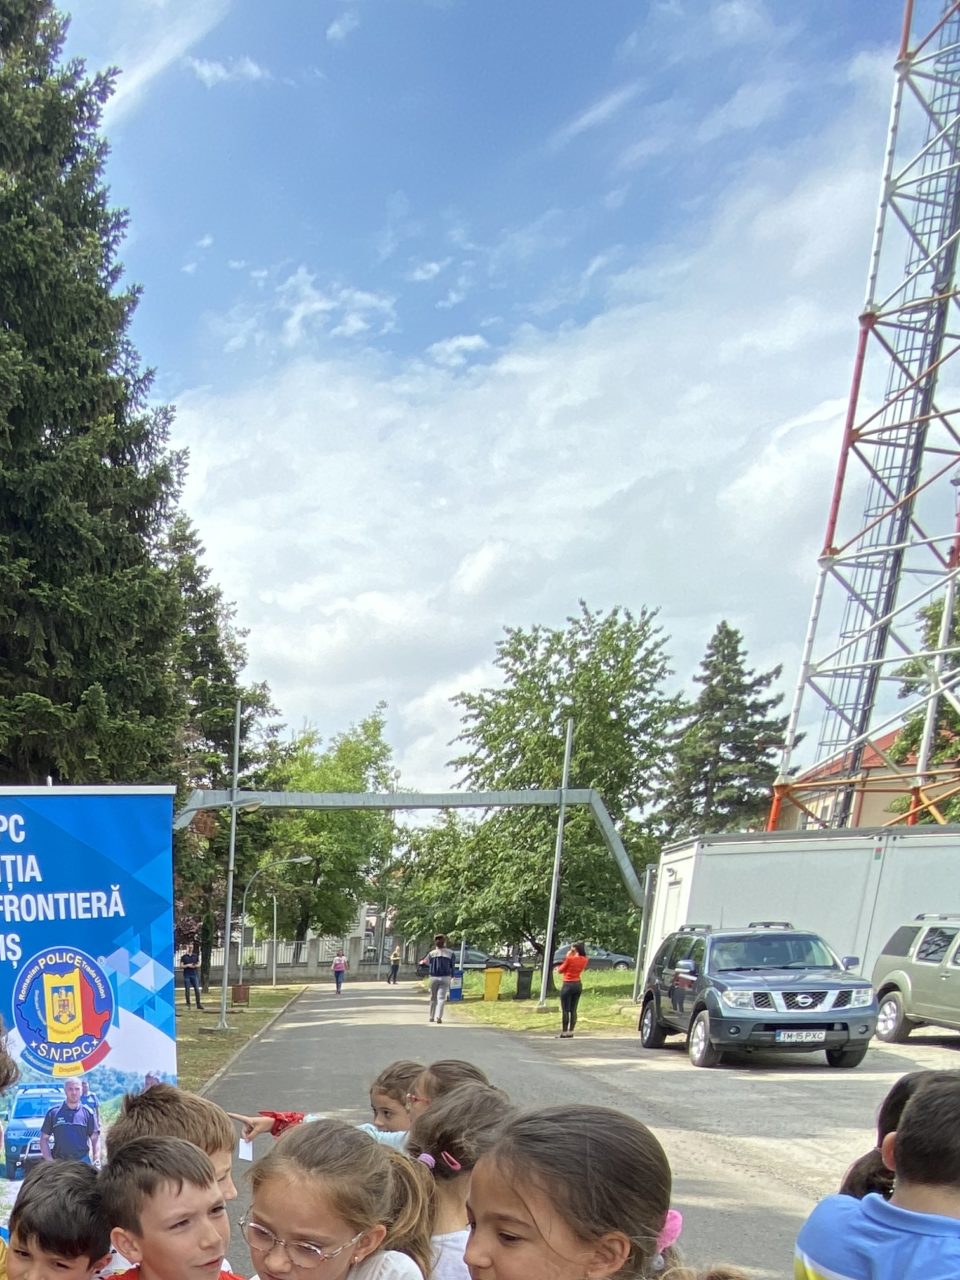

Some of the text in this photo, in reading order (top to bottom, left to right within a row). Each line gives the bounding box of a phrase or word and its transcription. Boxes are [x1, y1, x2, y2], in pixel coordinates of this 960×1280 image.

[18, 952, 107, 1001] Romanian POLICE Trade Union
